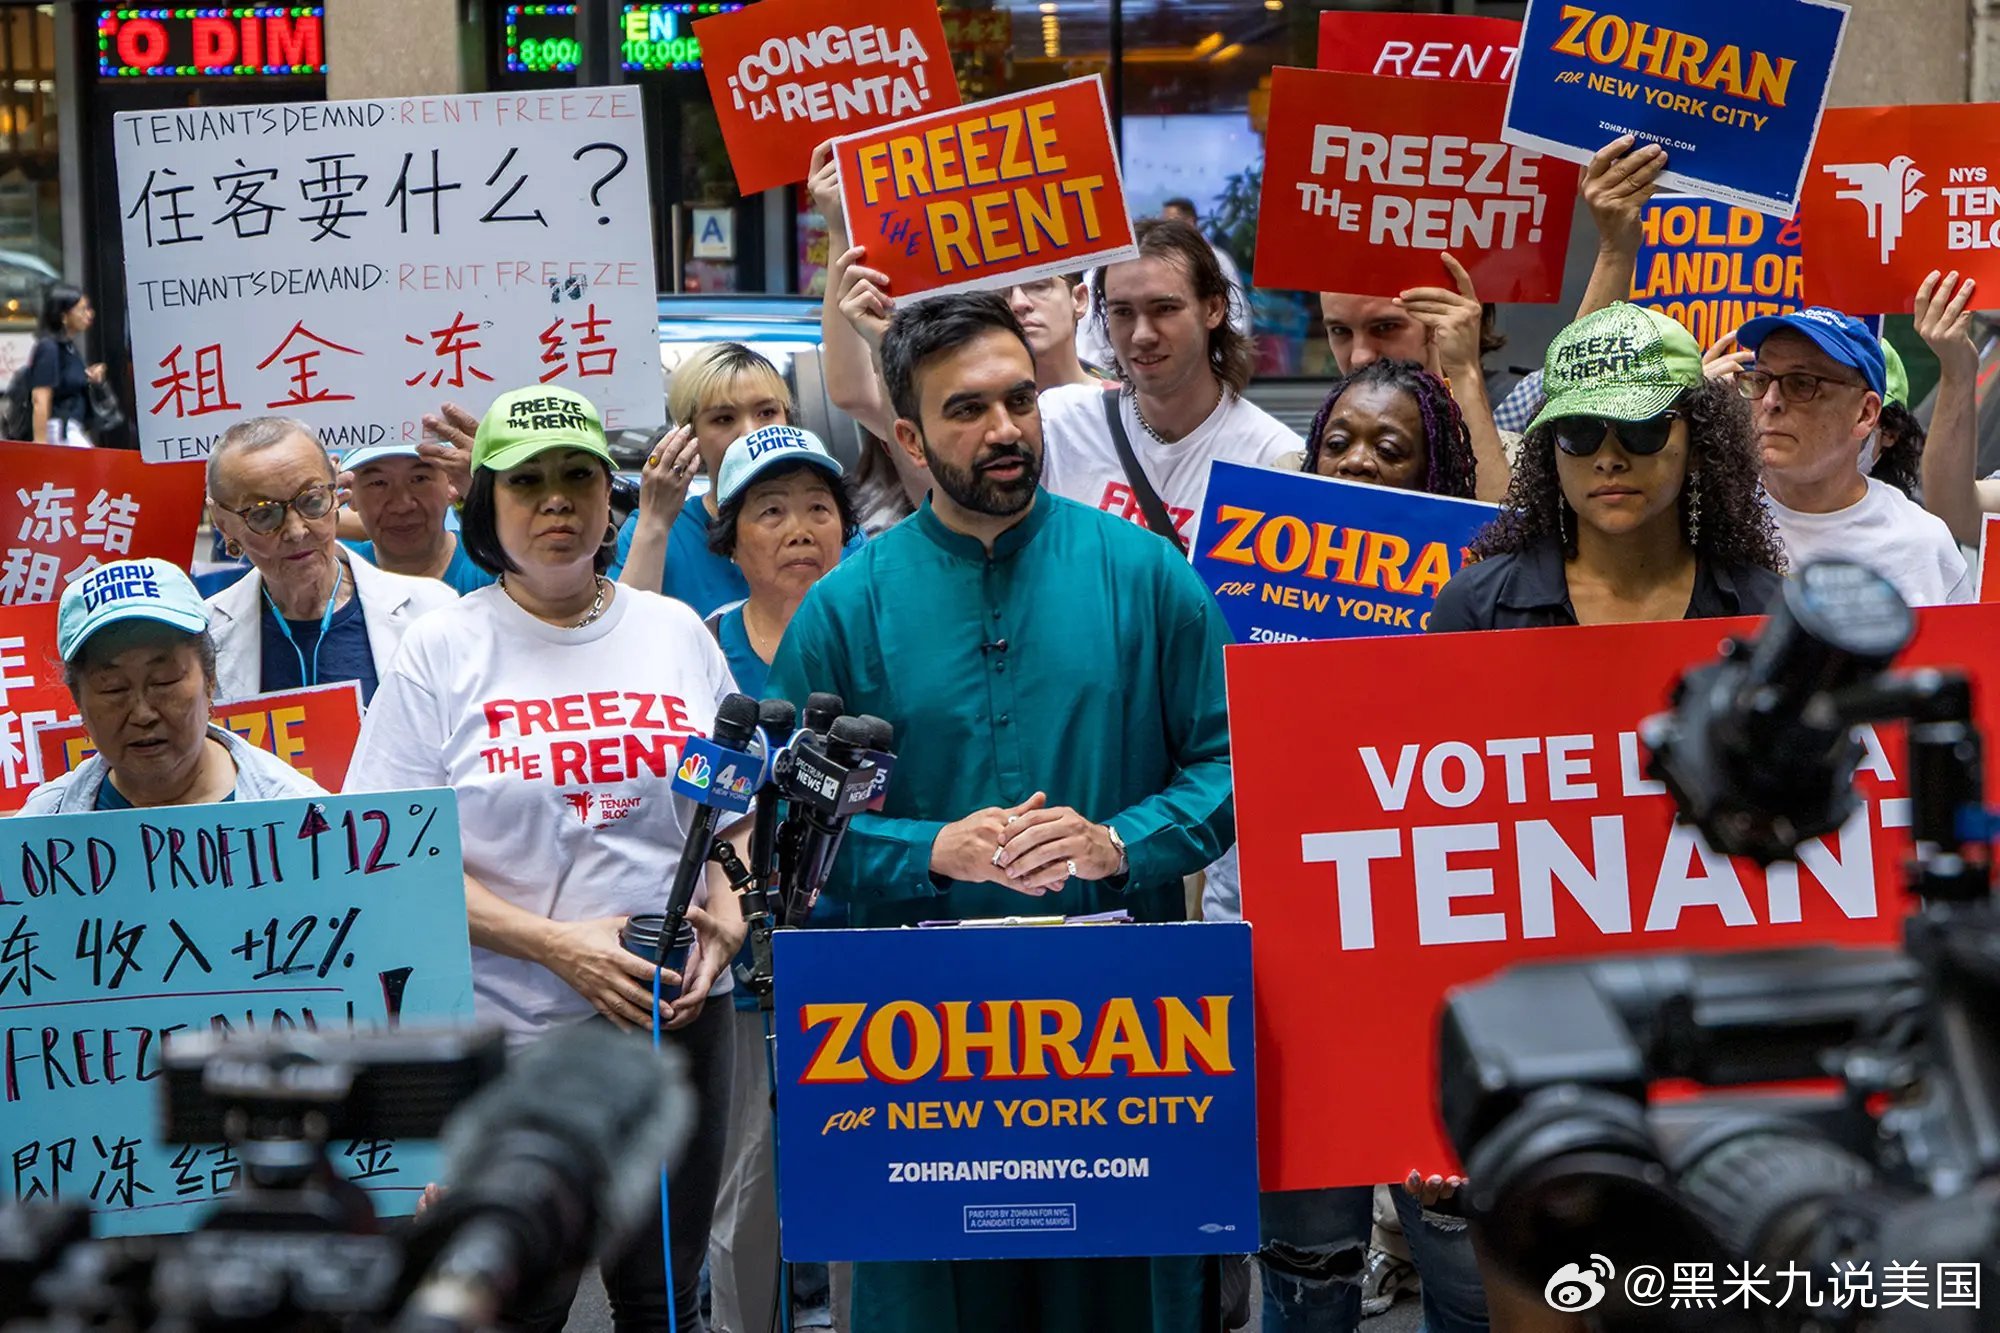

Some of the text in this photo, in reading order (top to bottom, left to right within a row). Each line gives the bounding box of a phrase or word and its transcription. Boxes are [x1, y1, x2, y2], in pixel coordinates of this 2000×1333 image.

[192, 17, 323, 68] DIM
[622, 11, 677, 42] EN
[727, 25, 928, 110] ¡CONGELA
[1551, 5, 1797, 107] ZOHRAN
[401, 101, 482, 124] RENT
[497, 95, 636, 126] FREEZE
[749, 65, 930, 122] LA RENTA!
[1554, 71, 1768, 132] FOR NEW YORK CITY
[857, 100, 1067, 207] FREEZE
[1598, 120, 1696, 153] ZOHRANFORNYC.COM
[1311, 124, 1544, 197] FREEZE
[1949, 167, 1988, 183] NYS
[701, 215, 725, 243] A
[880, 174, 1104, 275] THE RENT
[1296, 182, 1547, 250] THE RENT!
[1641, 206, 1764, 247] HOLD
[400, 264, 485, 290] RENT
[497, 262, 639, 287] FREEZE
[150, 303, 618, 417] 租金冻结
[1557, 336, 1634, 362] FREEZE
[506, 419, 530, 430] THE
[510, 397, 582, 417] FREEZE
[319, 424, 393, 446] MAND:
[748, 436, 809, 461] VOICE
[16, 482, 140, 555] 冻结
[1206, 505, 1477, 599] ZOHRA
[83, 565, 155, 595] CAAAV
[84, 580, 160, 615] VOICE
[1215, 581, 1255, 596] FOR
[1261, 583, 1330, 613] NEW
[1337, 596, 1414, 628] YORK
[483, 691, 697, 739] FREEZE
[480, 731, 706, 786] THE RENT
[716, 764, 737, 790] 4
[795, 757, 825, 781] SPECTRUM
[874, 768, 888, 784] 5
[1358, 735, 1598, 811] VOTE
[796, 770, 821, 793] NEWS
[600, 797, 641, 809] TENANT
[602, 809, 629, 819] BLOC
[0, 838, 116, 905] ORD
[139, 821, 285, 892] PROFIT
[1301, 798, 1912, 950] TENAN
[231, 907, 361, 981] +12%
[799, 995, 1236, 1084] ZOHRAN
[822, 1096, 1214, 1135] FOR NEW YORK CITY
[888, 1158, 1150, 1183] ZOHRANFORNYC.COM
